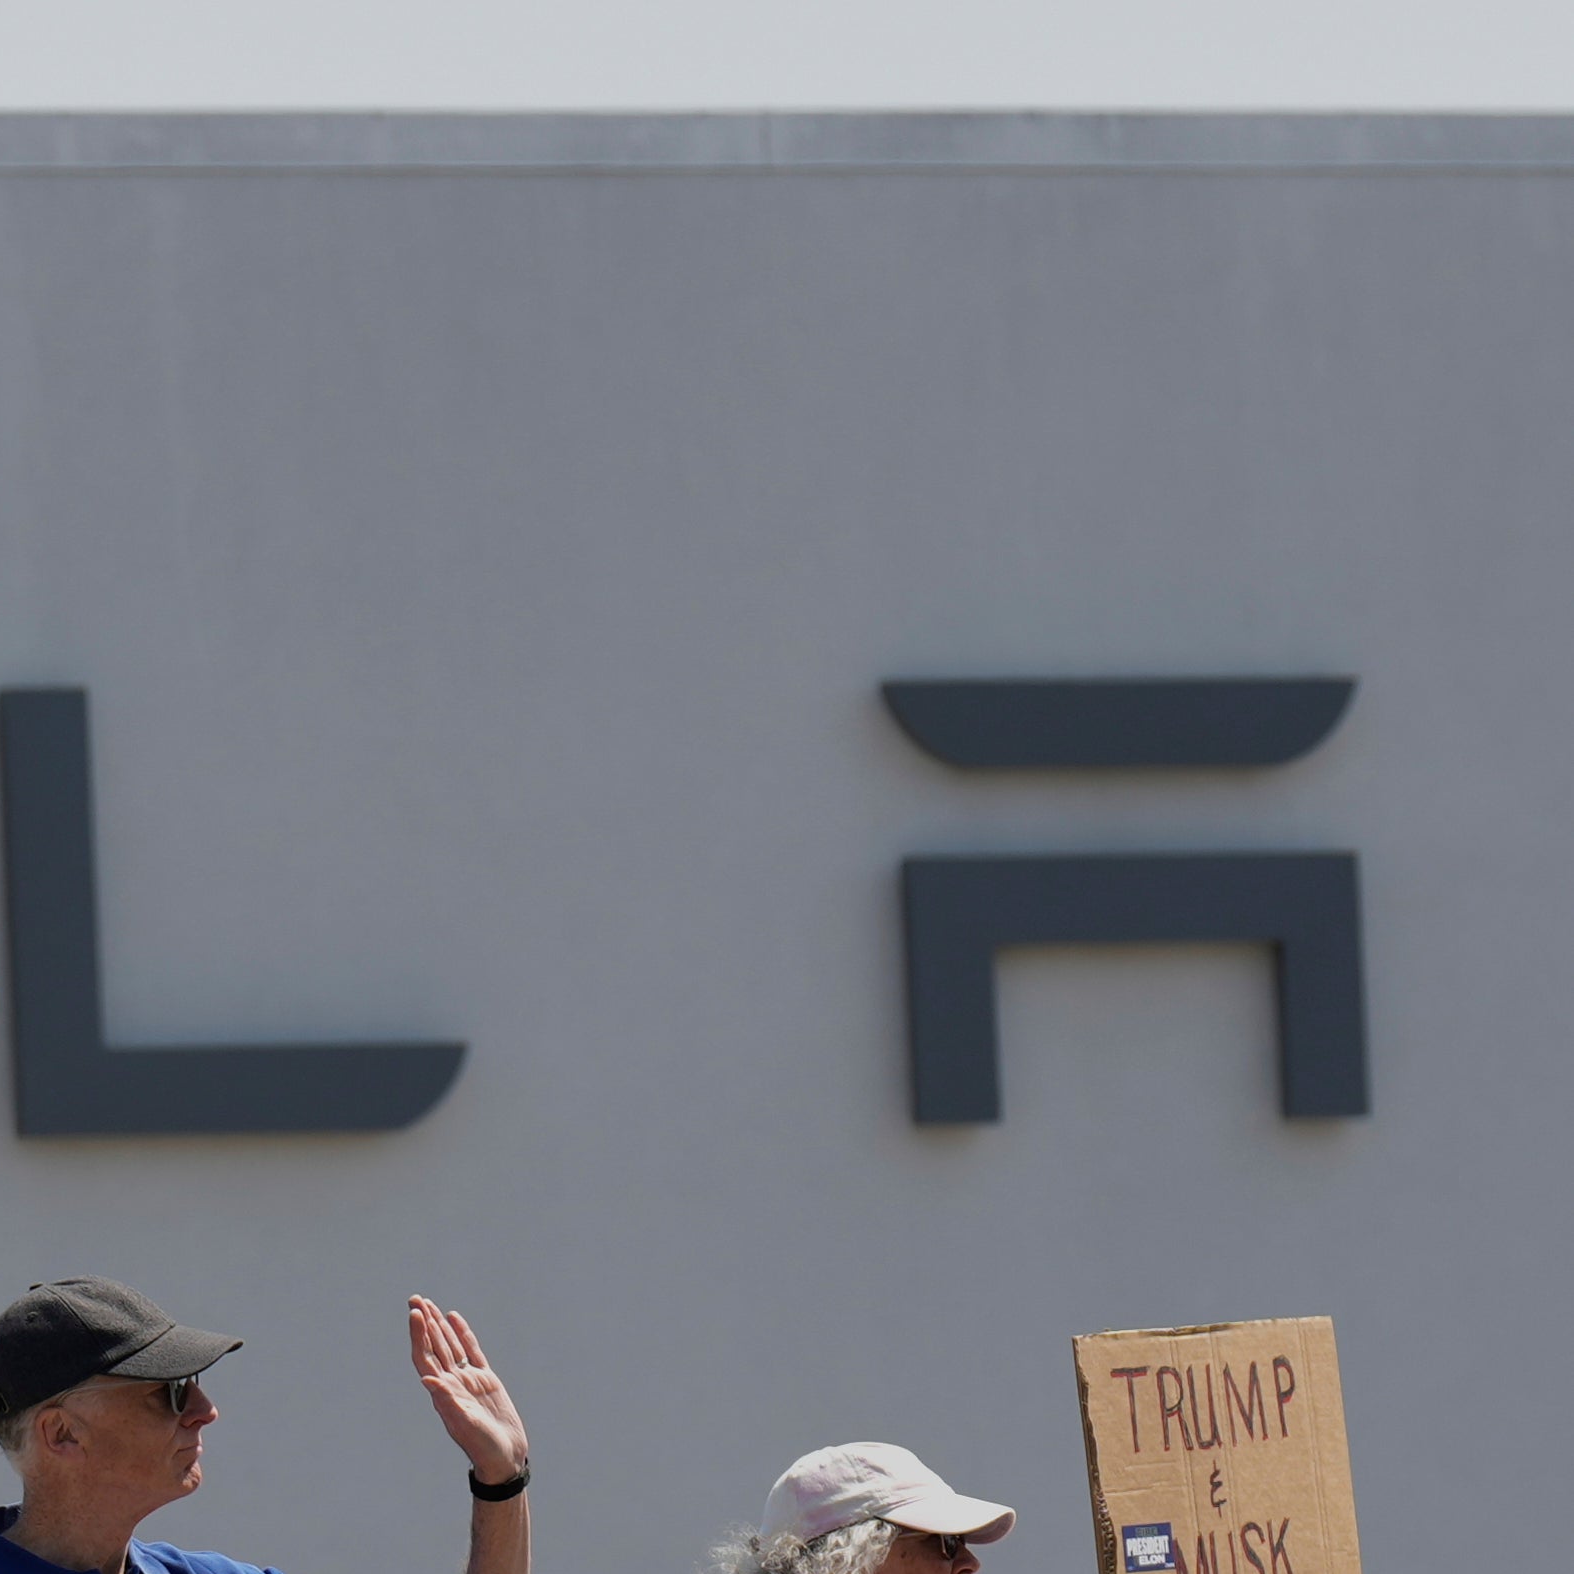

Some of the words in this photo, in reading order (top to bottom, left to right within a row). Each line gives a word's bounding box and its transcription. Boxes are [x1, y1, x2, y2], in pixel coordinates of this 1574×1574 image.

[1110, 1354, 1296, 1454] TRUMP
[1126, 1535, 1170, 1557] PRESIDENT
[1139, 1554, 1166, 1566] ELON
